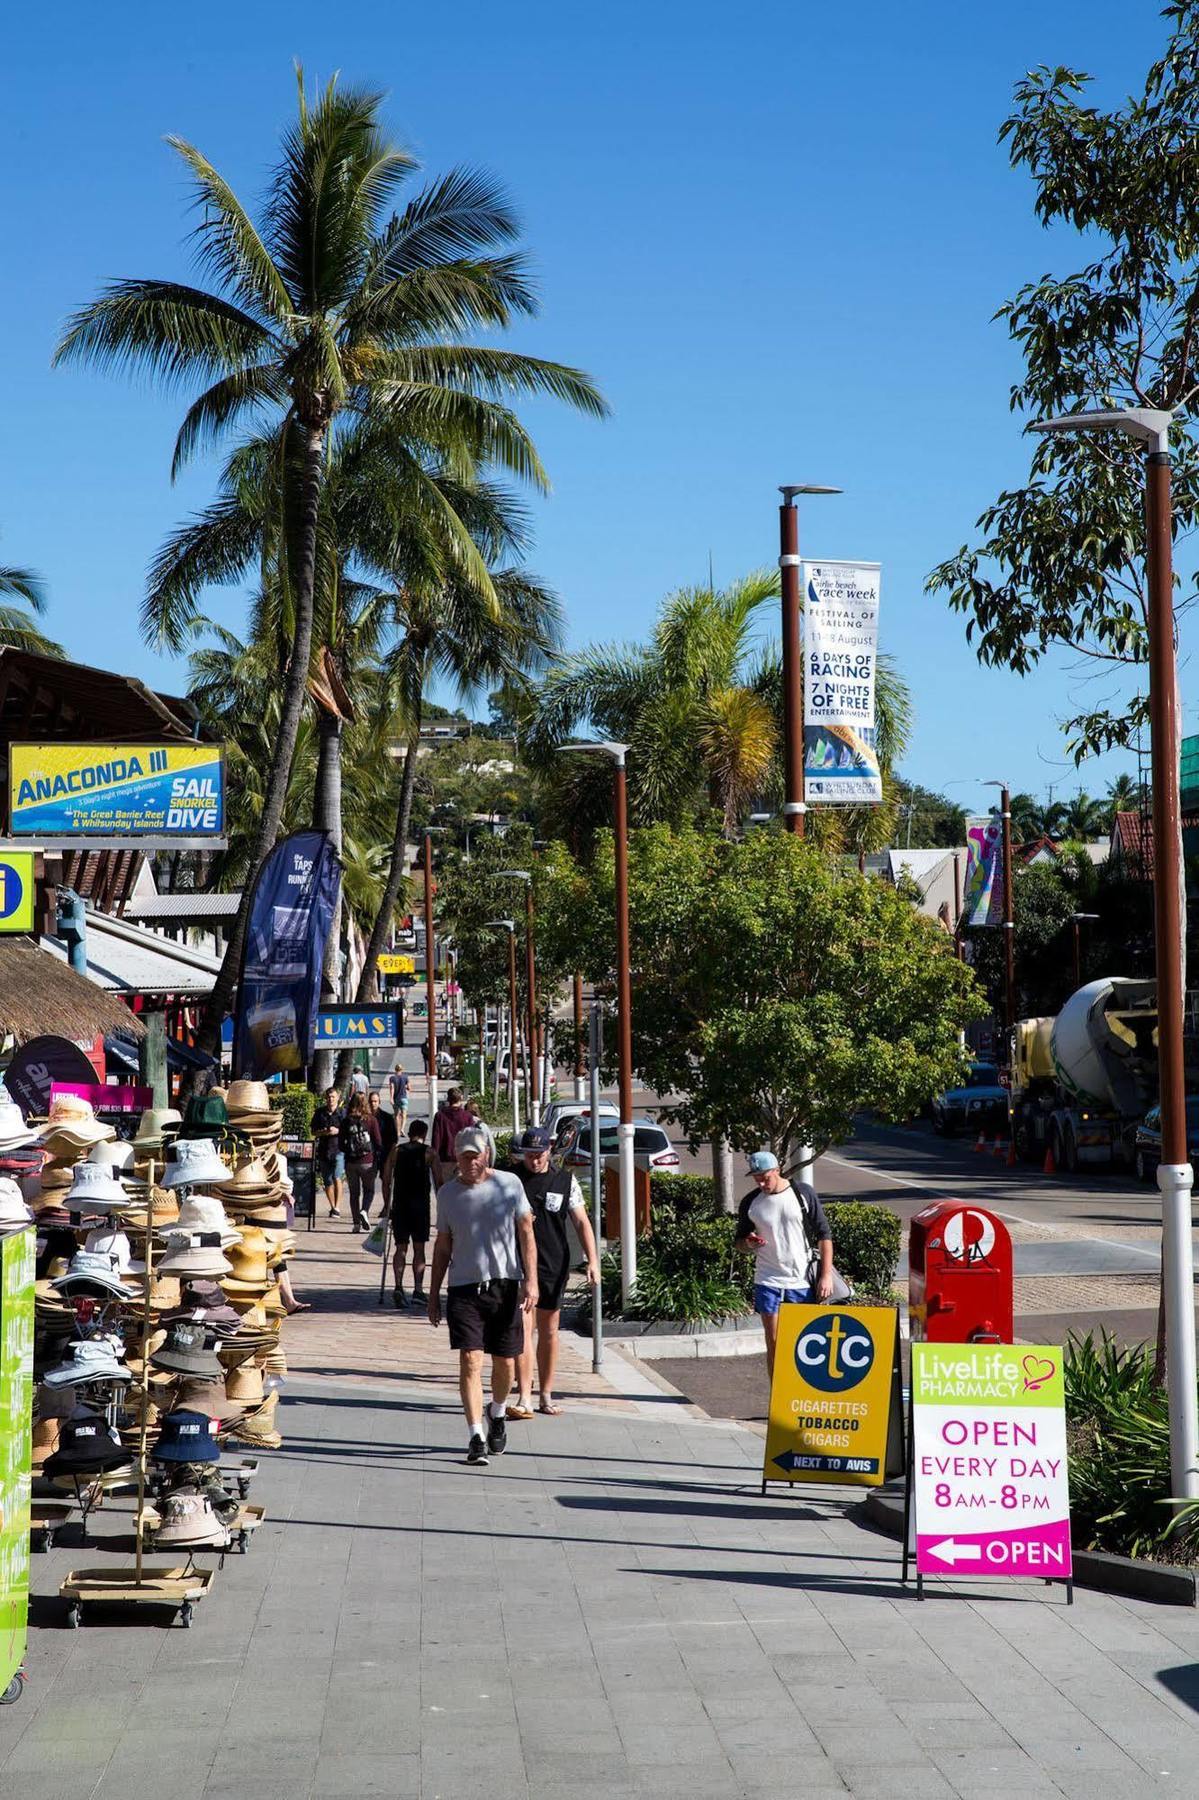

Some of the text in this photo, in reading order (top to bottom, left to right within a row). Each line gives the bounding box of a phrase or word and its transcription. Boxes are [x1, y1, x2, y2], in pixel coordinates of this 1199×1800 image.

[819, 588, 876, 600] race week
[810, 608, 856, 618] FESTIVAL
[821, 620, 862, 628] SAILING
[838, 634, 872, 646] August
[810, 652, 871, 665] 6 DAYS OF
[811, 663, 870, 679] RACING
[812, 683, 870, 696] 7 NIGHTS
[812, 695, 868, 710] OF FREE
[810, 709, 870, 718] ENTERTAINMENT
[18, 750, 168, 806] ANACONDA III
[171, 778, 218, 798] SAIL
[170, 798, 218, 808] SNORKEL
[116, 810, 142, 818] Barrier
[166, 809, 216, 828] DIVE
[82, 819, 131, 829] Whitsunday
[134, 819, 164, 827] Islands
[294, 860, 313, 871] TAPS
[920, 1352, 1019, 1380] LiveLife
[920, 1381, 1020, 1398] PHARMACY
[791, 1400, 868, 1416] CIGARETTES
[797, 1416, 859, 1431] TOBACCO
[803, 1432, 850, 1447] CIGARS
[942, 1420, 1036, 1446] OPEN
[794, 1456, 871, 1471] NEXT TO AVIS
[922, 1456, 1060, 1478] EVERY DAY
[986, 1540, 1063, 1565] OPEN
